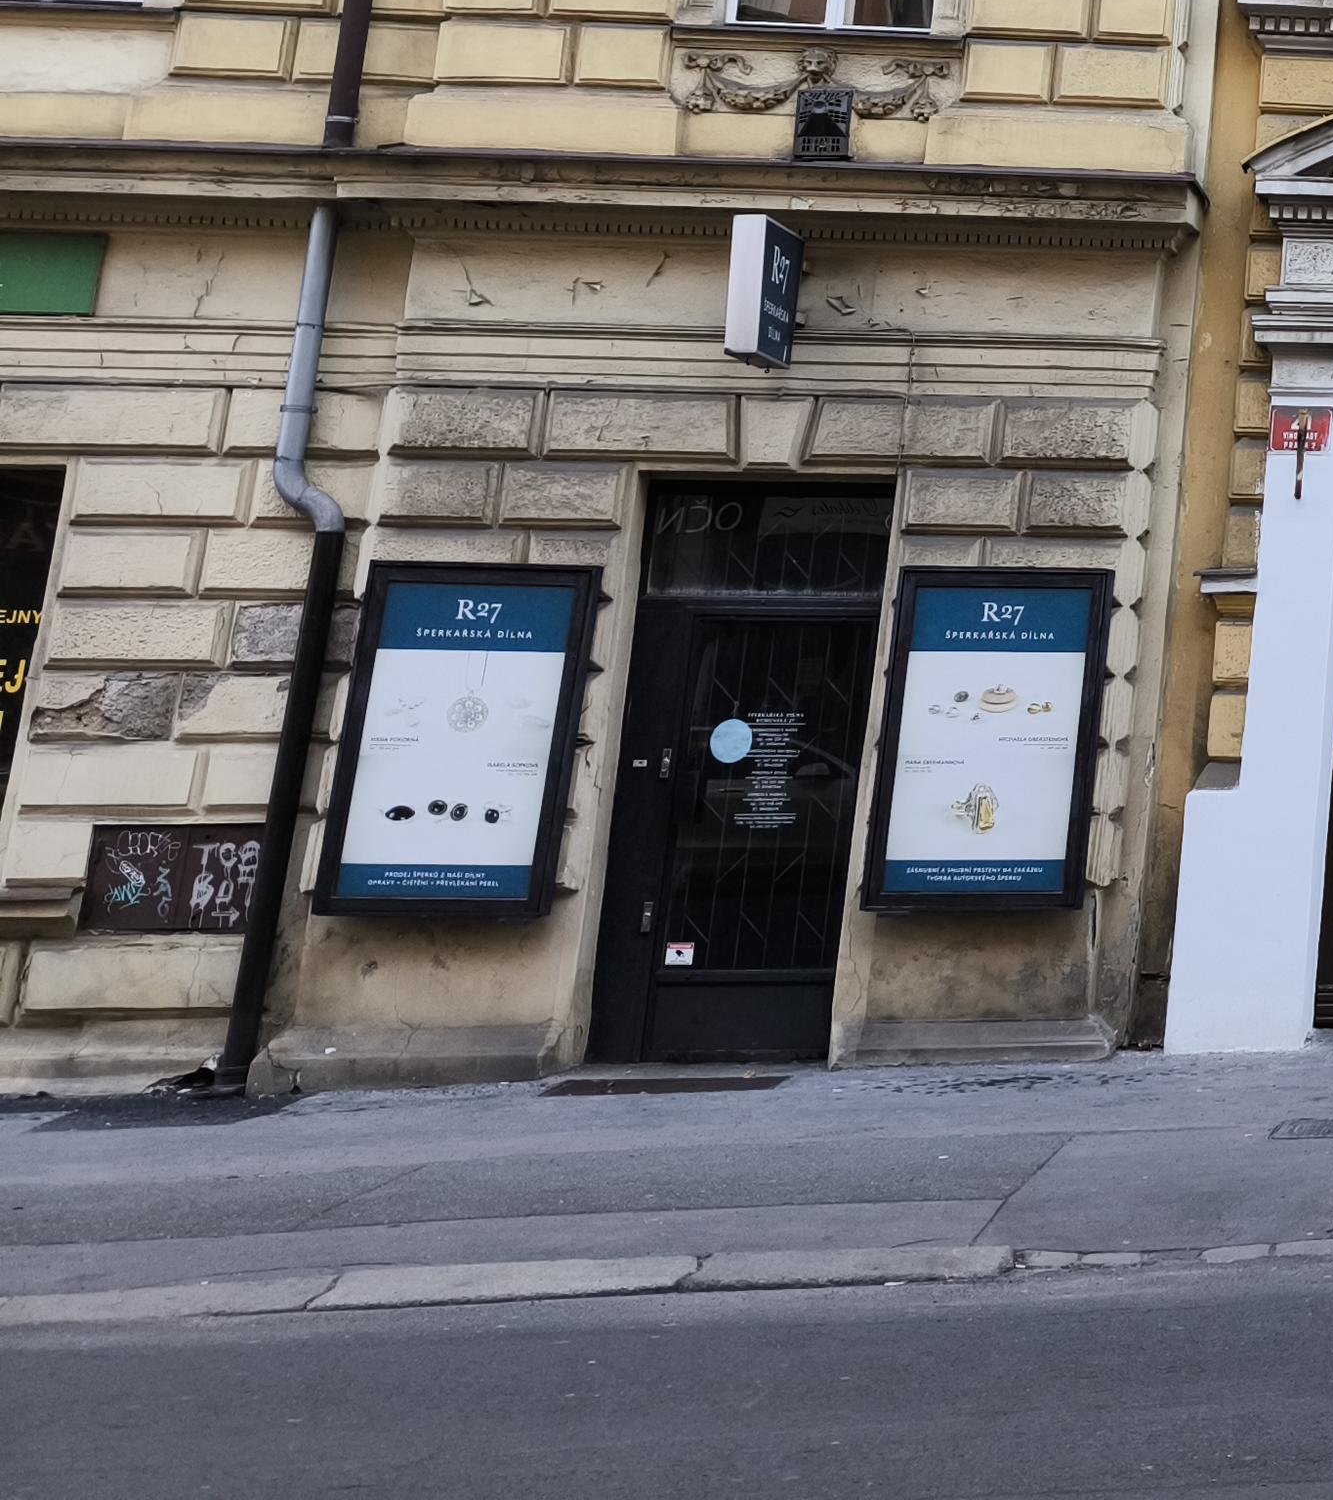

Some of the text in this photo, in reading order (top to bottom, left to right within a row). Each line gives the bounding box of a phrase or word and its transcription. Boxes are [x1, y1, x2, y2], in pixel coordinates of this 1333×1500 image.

[771, 245, 790, 294] R27
[1283, 441, 1308, 449] PRAA
[455, 599, 502, 624] R27
[980, 602, 1025, 626] R27
[416, 627, 532, 639] ŠPERKAŘSKÁ DÍLNA
[945, 629, 1055, 640] ŠPERKAŘSKÁ DÍLNA
